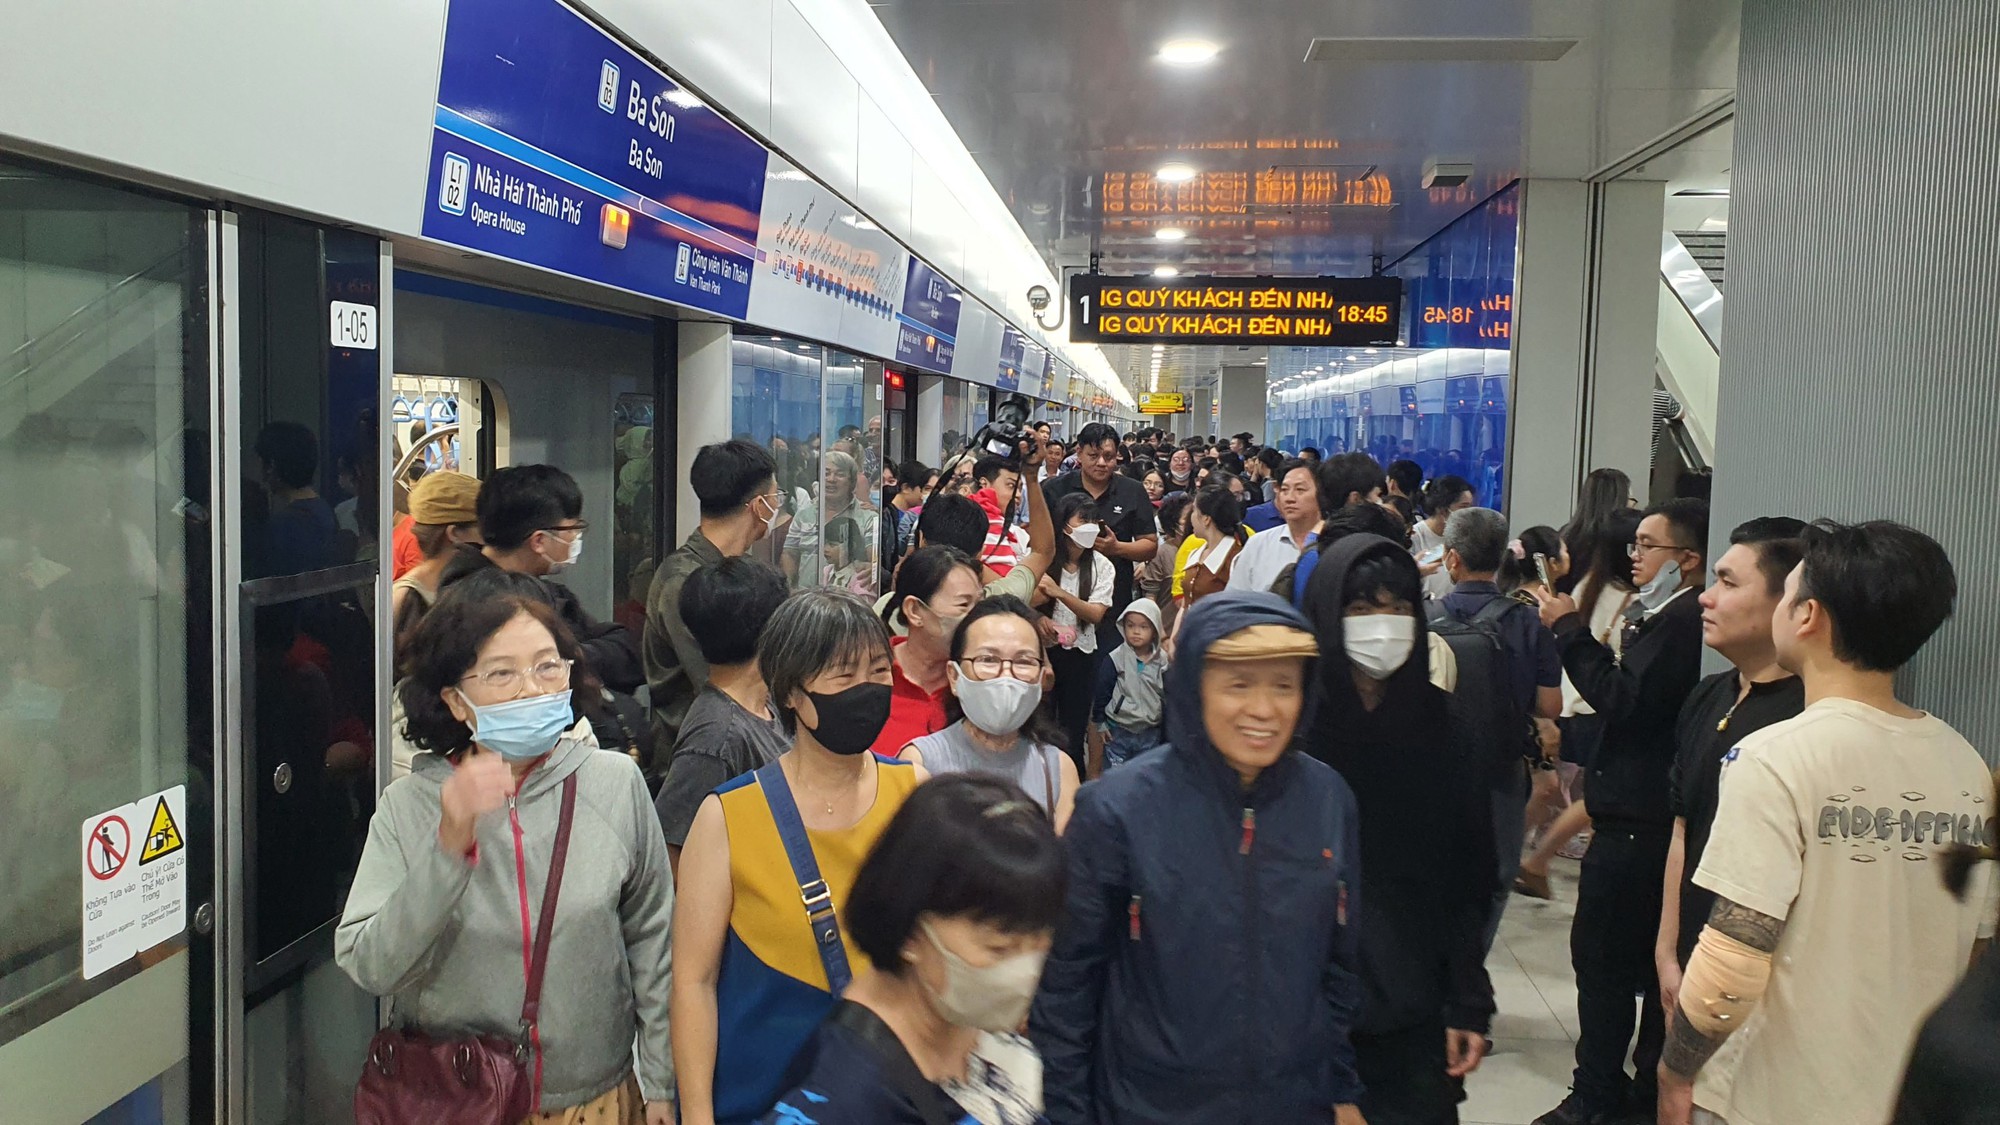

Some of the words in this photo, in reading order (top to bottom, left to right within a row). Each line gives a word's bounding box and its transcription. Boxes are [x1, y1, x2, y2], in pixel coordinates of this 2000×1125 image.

[606, 68, 614, 88] L1
[604, 87, 612, 105] 03
[627, 80, 647, 126] Ba
[648, 95, 675, 142] Son
[628, 138, 642, 170] Ba
[644, 147, 662, 180] Son
[450, 162, 462, 184] L1
[448, 185, 460, 206] 02
[474, 164, 500, 198] Nhà
[503, 174, 524, 205] Hát
[526, 182, 559, 218] Thành
[560, 197, 584, 226] Phố
[471, 202, 498, 227] Opera
[499, 211, 526, 236] House
[692, 248, 708, 274] Công
[1126, 286, 1171, 308] QUÝ
[1172, 287, 1243, 308] KHÁCH
[1080, 294, 1090, 324] 1
[1338, 304, 1388, 322] 18:45
[338, 308, 368, 344] 1-05
[1125, 313, 1170, 334] QUÝ
[1172, 314, 1242, 334] KHÁCH
[141, 868, 153, 882] Chú
[176, 856, 184, 866] Có
[166, 872, 178, 882] Vào
[86, 895, 108, 912] Không
[110, 890, 122, 902] Tựa
[124, 882, 136, 894] vào
[142, 890, 160, 903] Trong
[88, 908, 102, 922] Cửa
